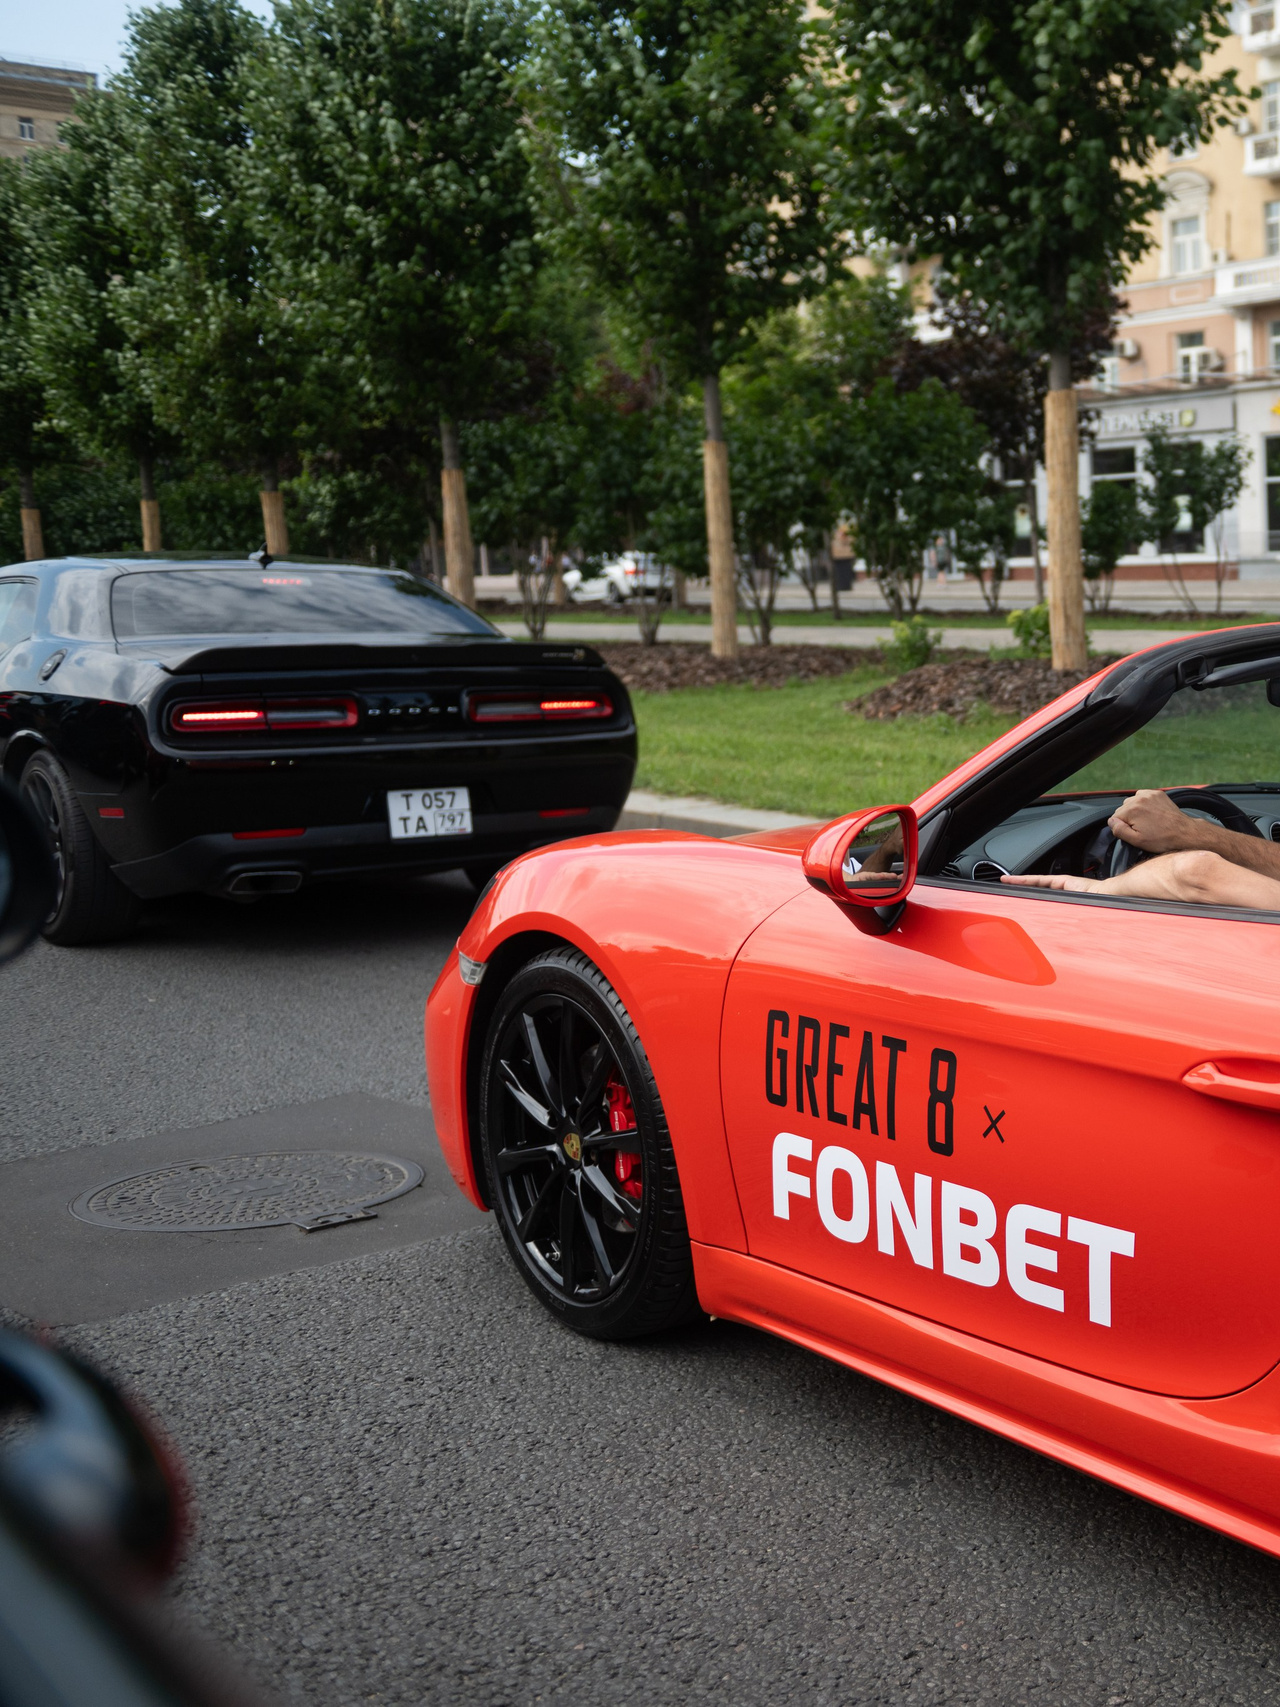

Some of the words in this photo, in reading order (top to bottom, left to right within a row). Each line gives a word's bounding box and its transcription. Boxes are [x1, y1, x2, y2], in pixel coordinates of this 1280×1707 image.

[421, 791, 456, 810] 057
[438, 812, 464, 827] 797
[765, 1009, 907, 1141] GREAT
[927, 1047, 957, 1157] 8
[772, 1132, 1136, 1328] FONBET
